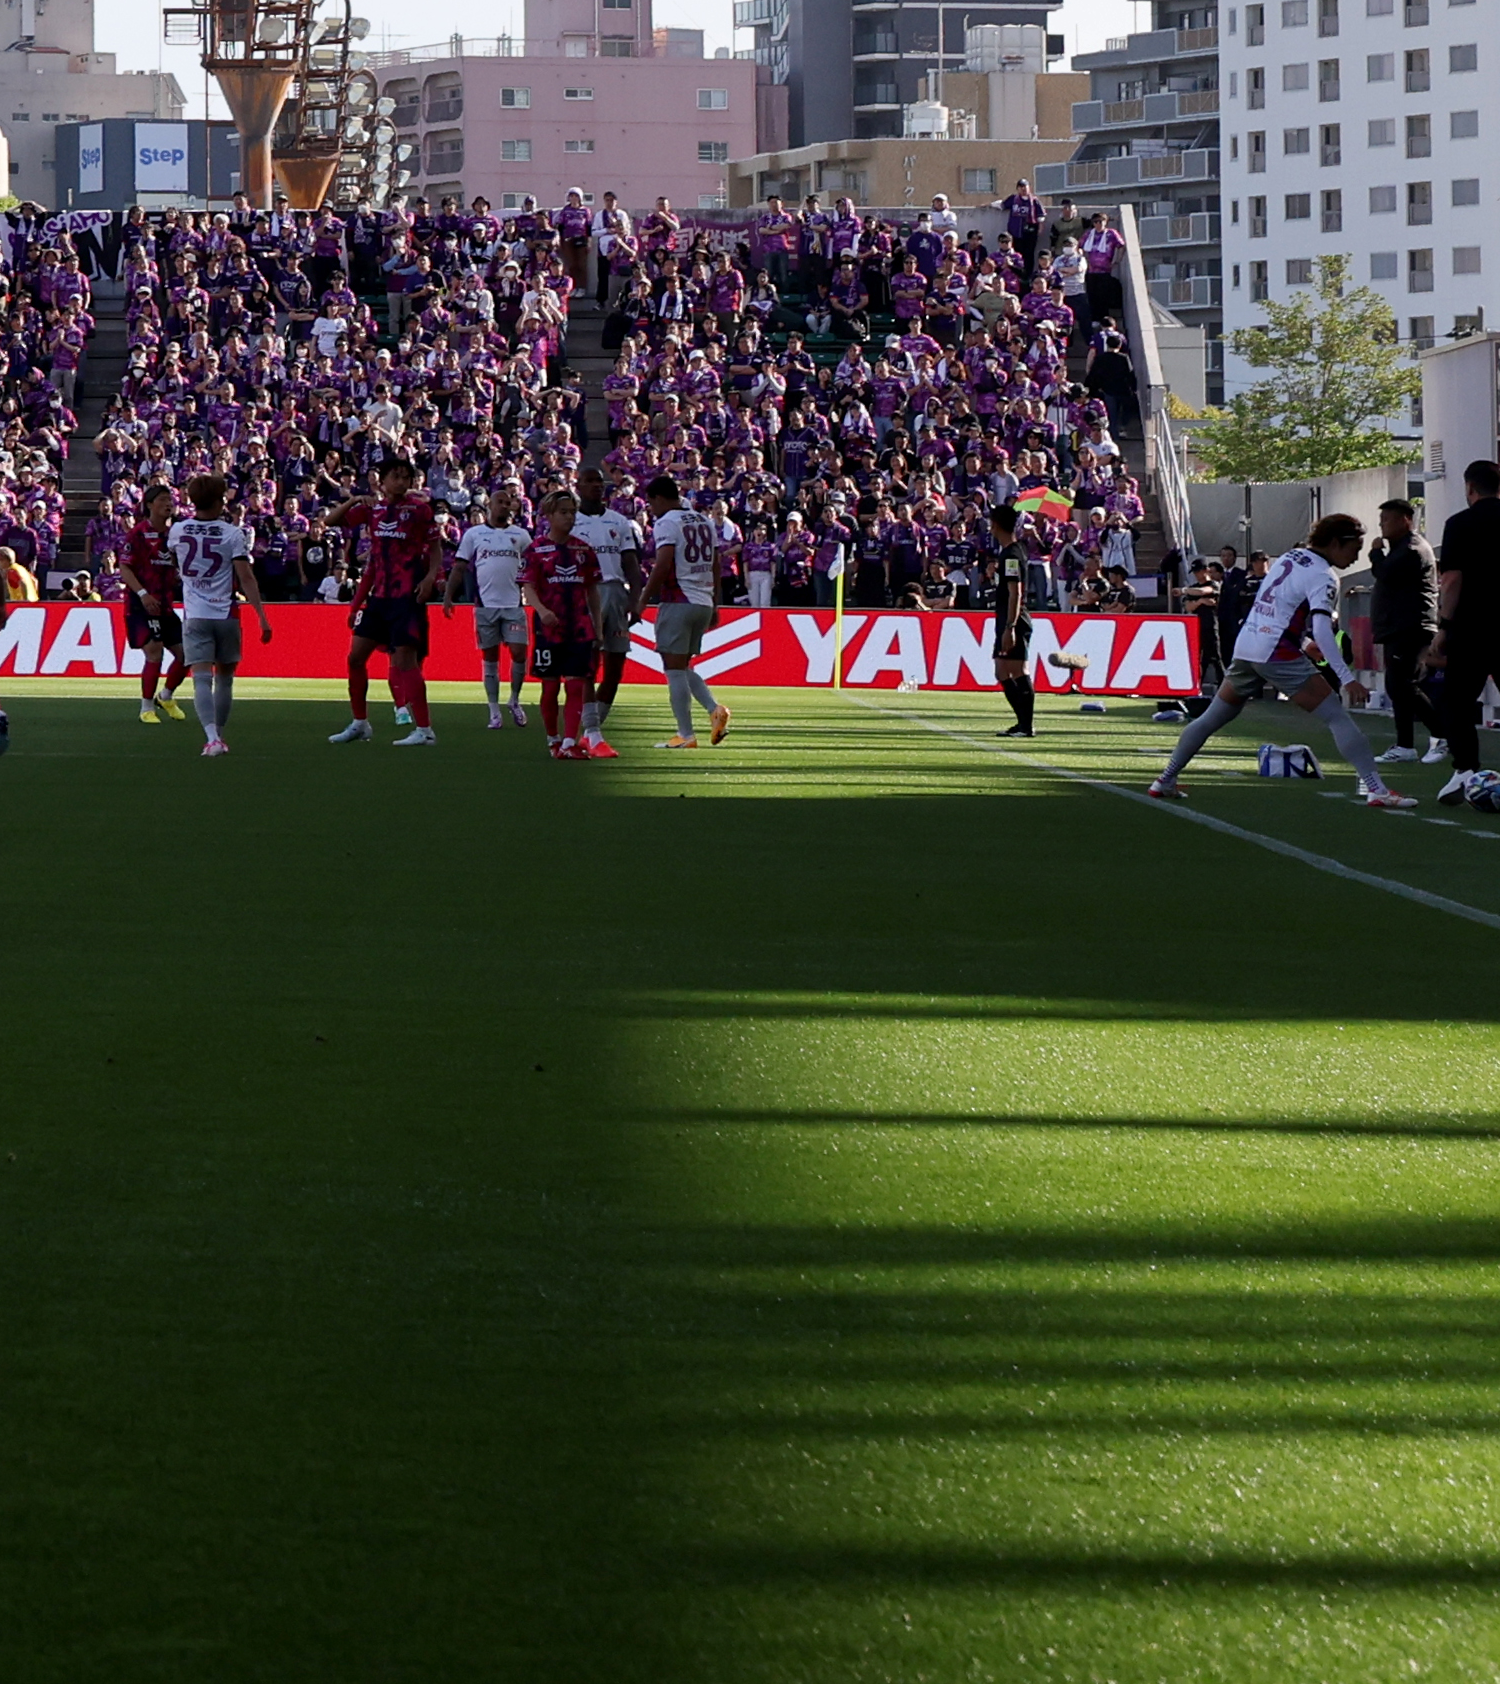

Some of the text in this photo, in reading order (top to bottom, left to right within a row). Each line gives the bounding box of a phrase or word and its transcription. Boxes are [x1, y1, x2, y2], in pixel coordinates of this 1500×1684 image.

[139, 147, 185, 166] Step
[180, 535, 223, 577] 25
[682, 524, 713, 563] 88
[1260, 559, 1293, 604] 2
[535, 648, 552, 667] 19
